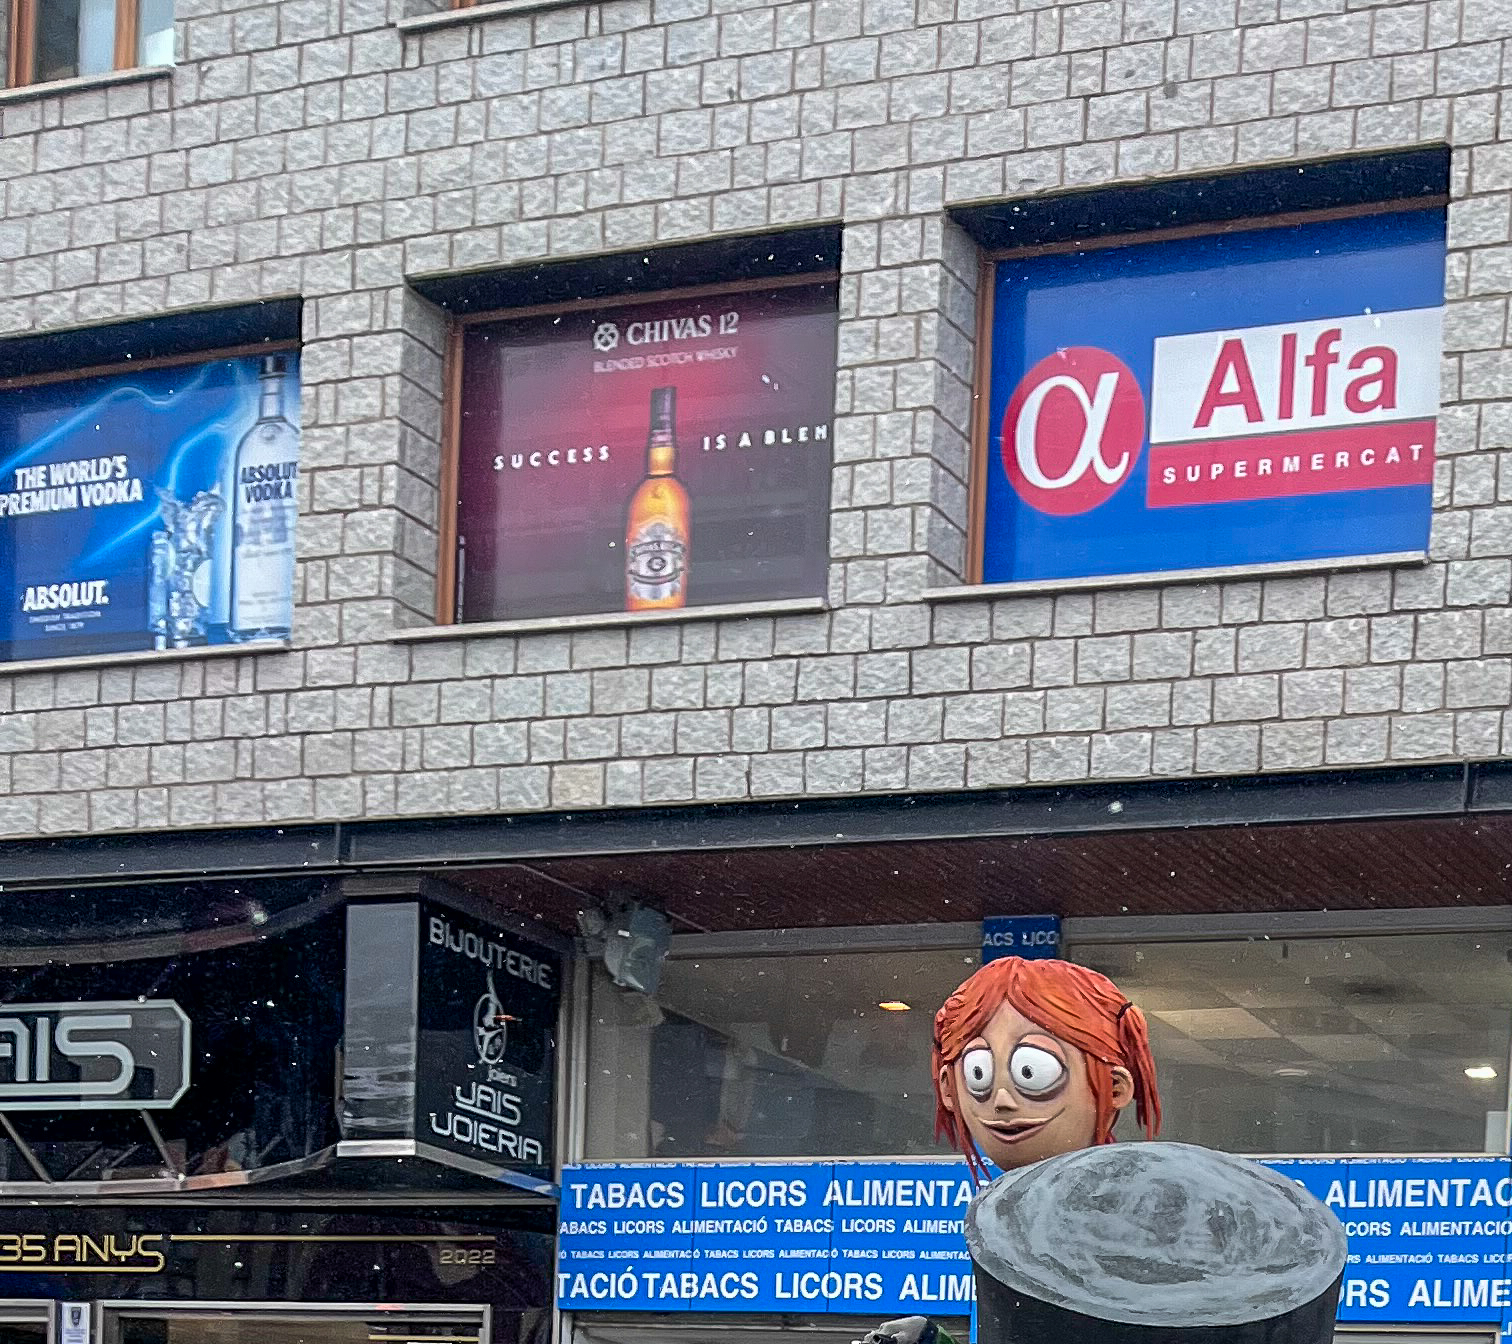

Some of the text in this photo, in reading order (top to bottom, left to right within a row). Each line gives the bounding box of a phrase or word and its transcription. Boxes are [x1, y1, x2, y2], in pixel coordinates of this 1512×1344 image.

[627, 312, 739, 346] CHIVAS 12
[1193, 328, 1399, 429] Alfa
[494, 444, 611, 471] SUCCESS
[704, 434, 727, 451] IS
[739, 432, 752, 447] A
[1162, 443, 1424, 485] SUPERMERCAT
[15, 455, 128, 491] THE WORLD'S
[0, 478, 143, 517] PREMIUM VODKA
[245, 481, 292, 503] VODKA
[429, 917, 552, 990] BIJOUTERIE
[455, 1082, 521, 1126] JAIS
[429, 1111, 542, 1165] JOIERIA
[571, 1180, 806, 1209] TABACS LICORS
[614, 1221, 664, 1234] LICORS
[672, 1216, 767, 1233] ALIMENTACIÓ
[775, 1219, 834, 1232] TABACS
[842, 1219, 895, 1232] LICORS
[54, 1234, 166, 1272] ANYS
[705, 1250, 738, 1258] TABACS
[743, 1250, 774, 1258] LICORS
[842, 1250, 878, 1258] TABACS
[882, 1250, 915, 1259] LICORS
[1366, 1252, 1433, 1263] ALIMENTACIÓ
[1438, 1254, 1479, 1263] TABACS
[557, 1265, 882, 1300] TACIÓ TABACS LICORS
